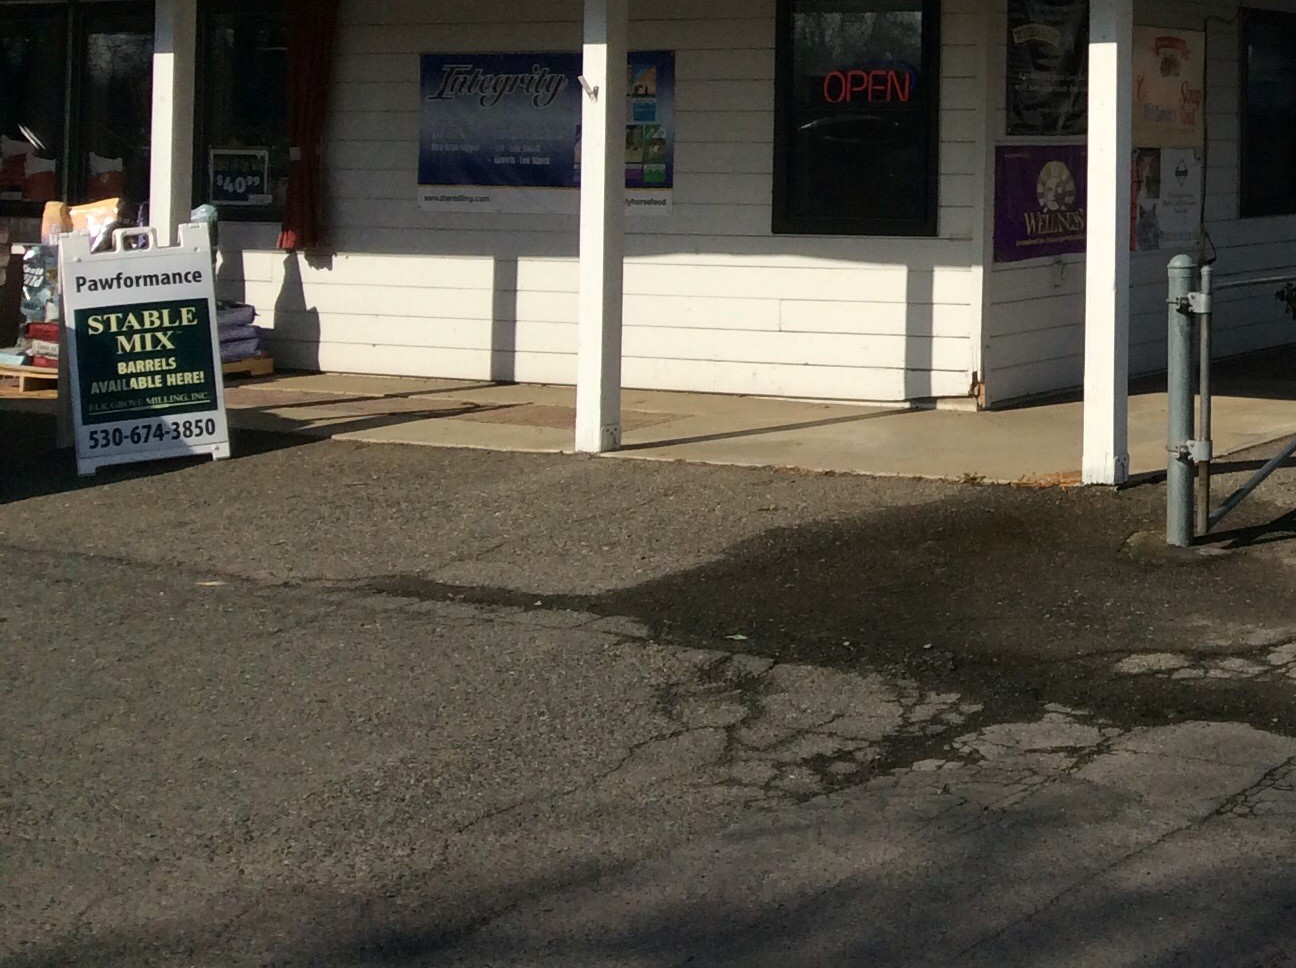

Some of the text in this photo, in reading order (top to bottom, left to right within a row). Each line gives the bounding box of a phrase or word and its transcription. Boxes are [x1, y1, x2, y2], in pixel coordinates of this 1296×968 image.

[425, 63, 569, 108] Integrity
[823, 69, 911, 104] OPEN
[76, 269, 202, 293] Pawformance
[88, 307, 197, 335] STABLE
[116, 331, 176, 354] MIX
[117, 357, 177, 375] BARRELS
[91, 371, 205, 395] AVAILABLE HERE!
[89, 418, 216, 449] 530-674-3850
